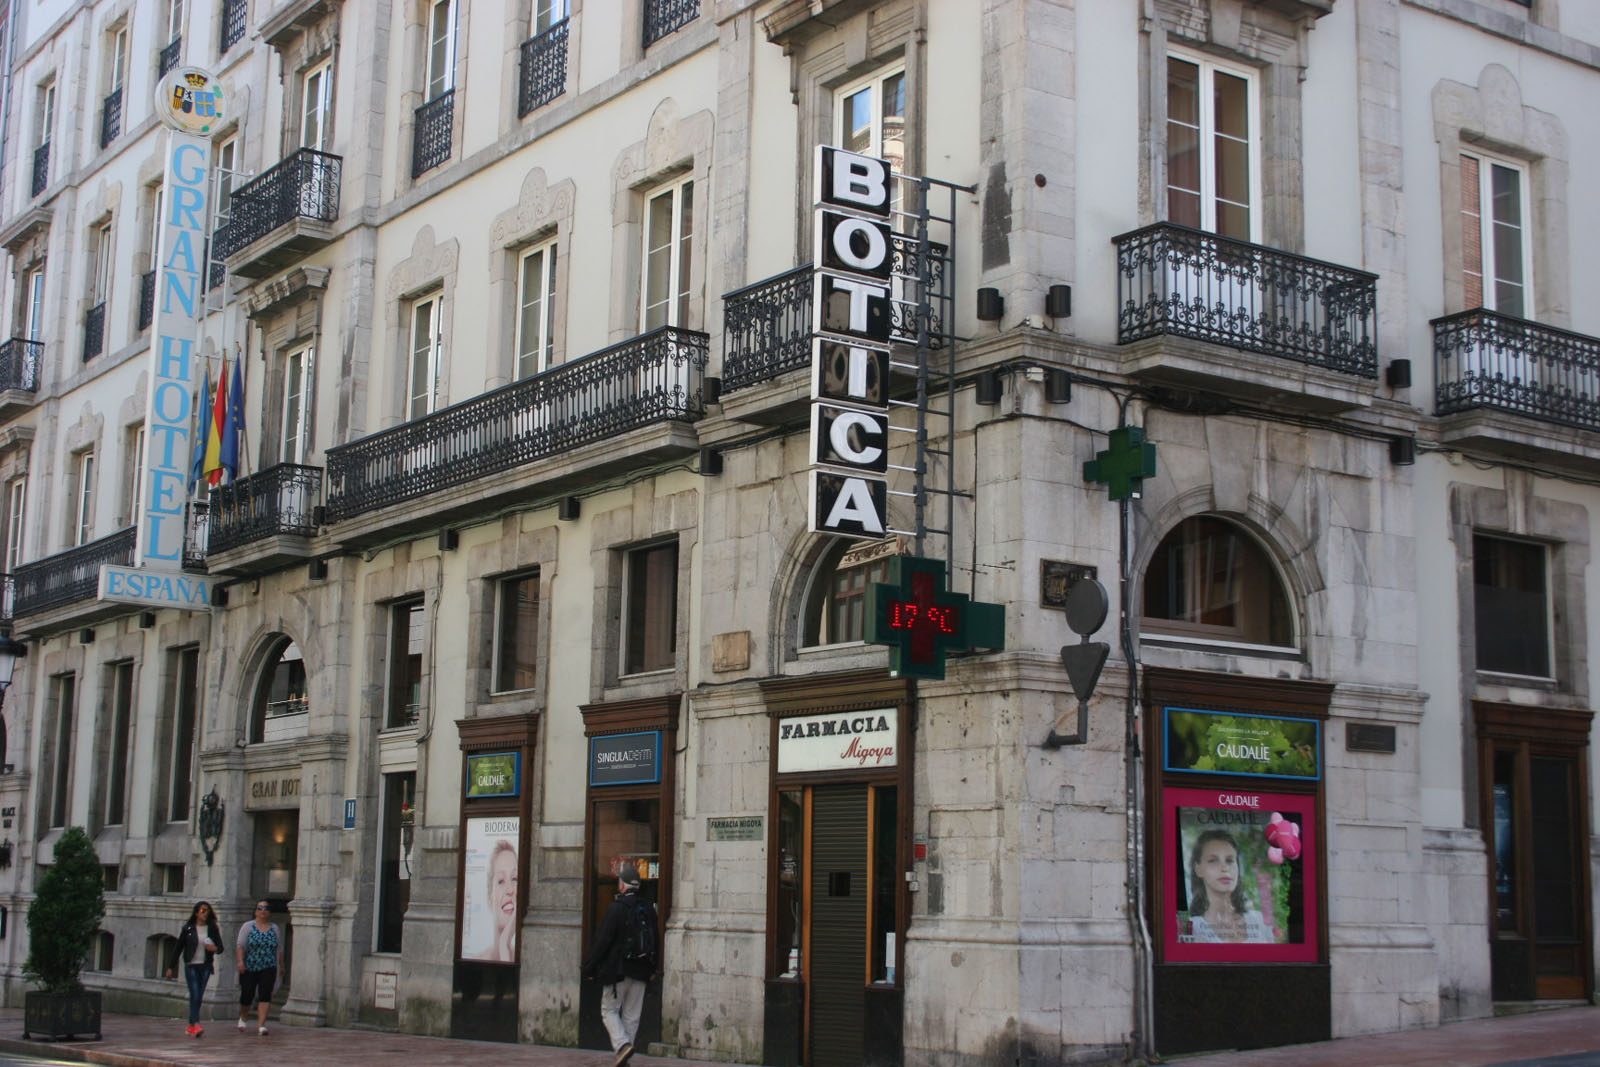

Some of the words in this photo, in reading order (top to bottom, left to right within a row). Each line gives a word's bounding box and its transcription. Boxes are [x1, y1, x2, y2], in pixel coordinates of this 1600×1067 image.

[161, 144, 207, 319] GRAN
[824, 150, 887, 533] BOTICA
[144, 335, 194, 561] HOTEL
[108, 571, 209, 604] ESPAÑA
[891, 603, 917, 628] 17
[780, 715, 890, 740] FARMACIA
[840, 736, 894, 766] Migoya
[252, 780, 278, 799] GRAN
[1218, 794, 1260, 807] CAUDALIE
[711, 820, 739, 829] FARMACIA
